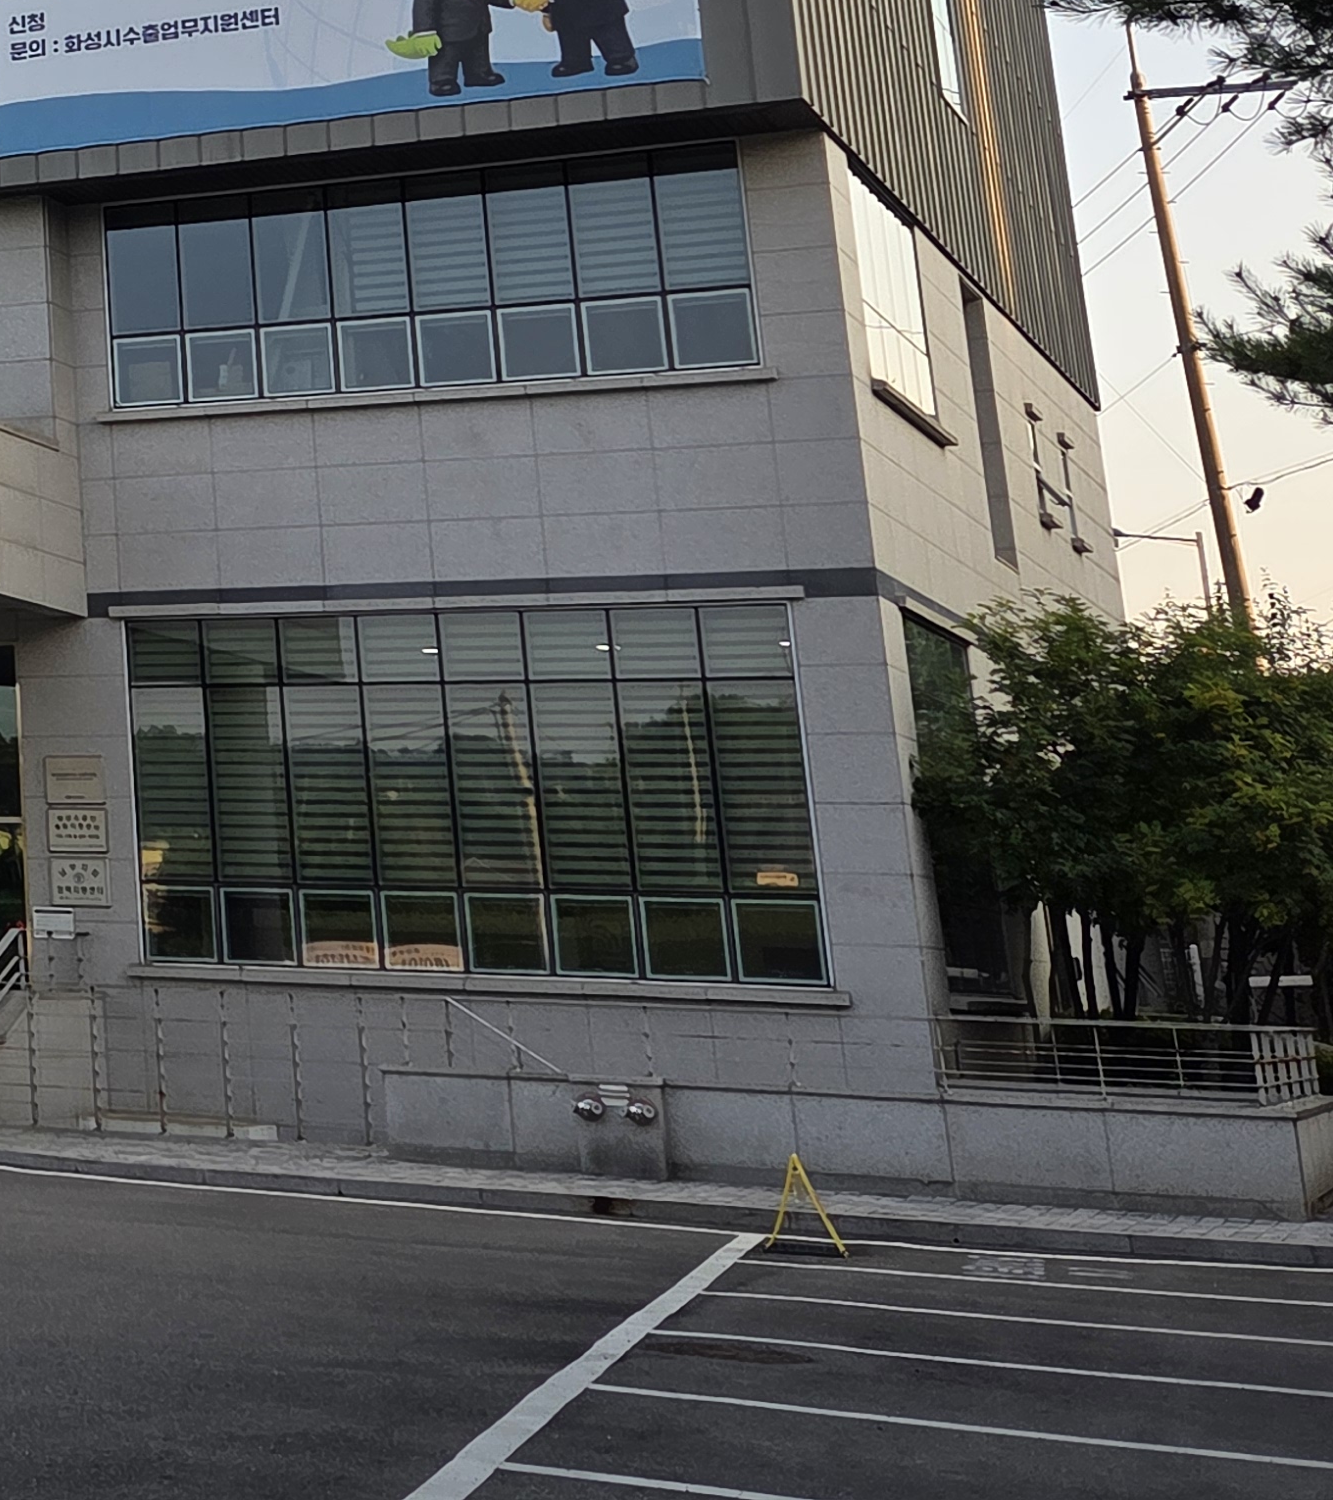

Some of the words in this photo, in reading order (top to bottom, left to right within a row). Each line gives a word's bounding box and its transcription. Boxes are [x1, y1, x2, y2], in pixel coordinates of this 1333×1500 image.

[8, 12, 46, 35] 신청
[9, 38, 47, 61] 문의
[64, 7, 280, 55] 화성시수출업무지원센터
